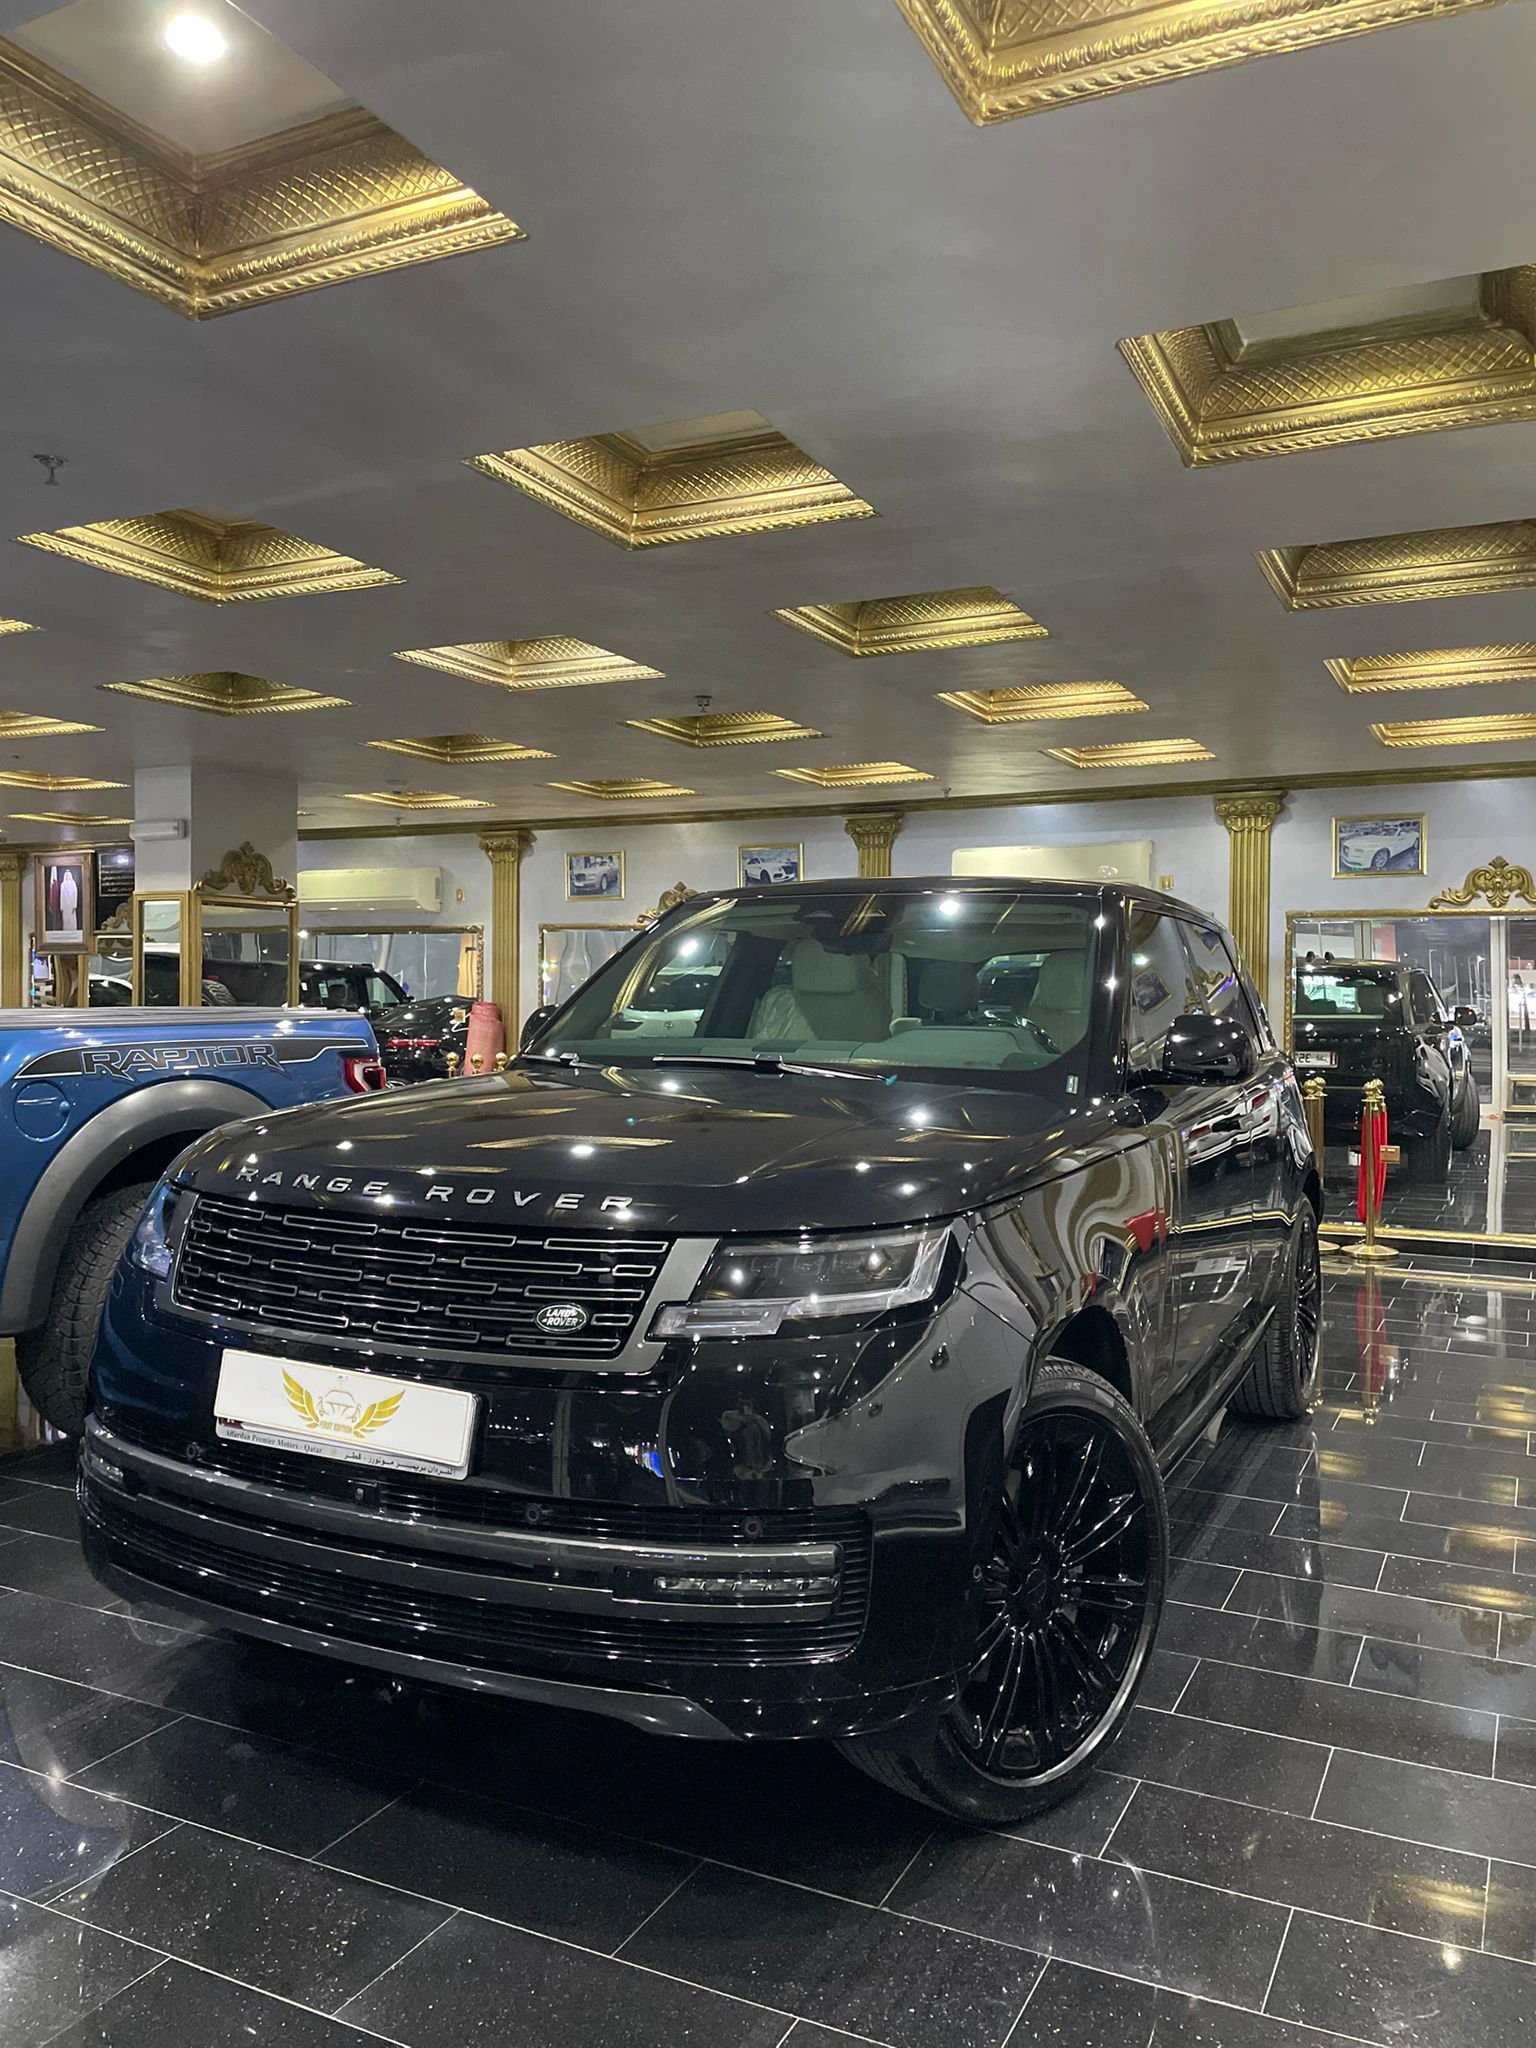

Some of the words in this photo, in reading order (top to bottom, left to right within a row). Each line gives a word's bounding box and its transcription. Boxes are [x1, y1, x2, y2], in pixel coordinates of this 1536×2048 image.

[81, 1044, 286, 1082] RAPTOR
[235, 1166, 390, 1196] RANGE
[424, 1185, 633, 1213] ROVER
[546, 1308, 572, 1317] LAND
[546, 1317, 579, 1327] ROVER
[225, 1429, 251, 1440] Alfardan
[252, 1433, 275, 1445] Premier
[276, 1438, 299, 1450] Motors
[303, 1443, 323, 1454] Qatar
